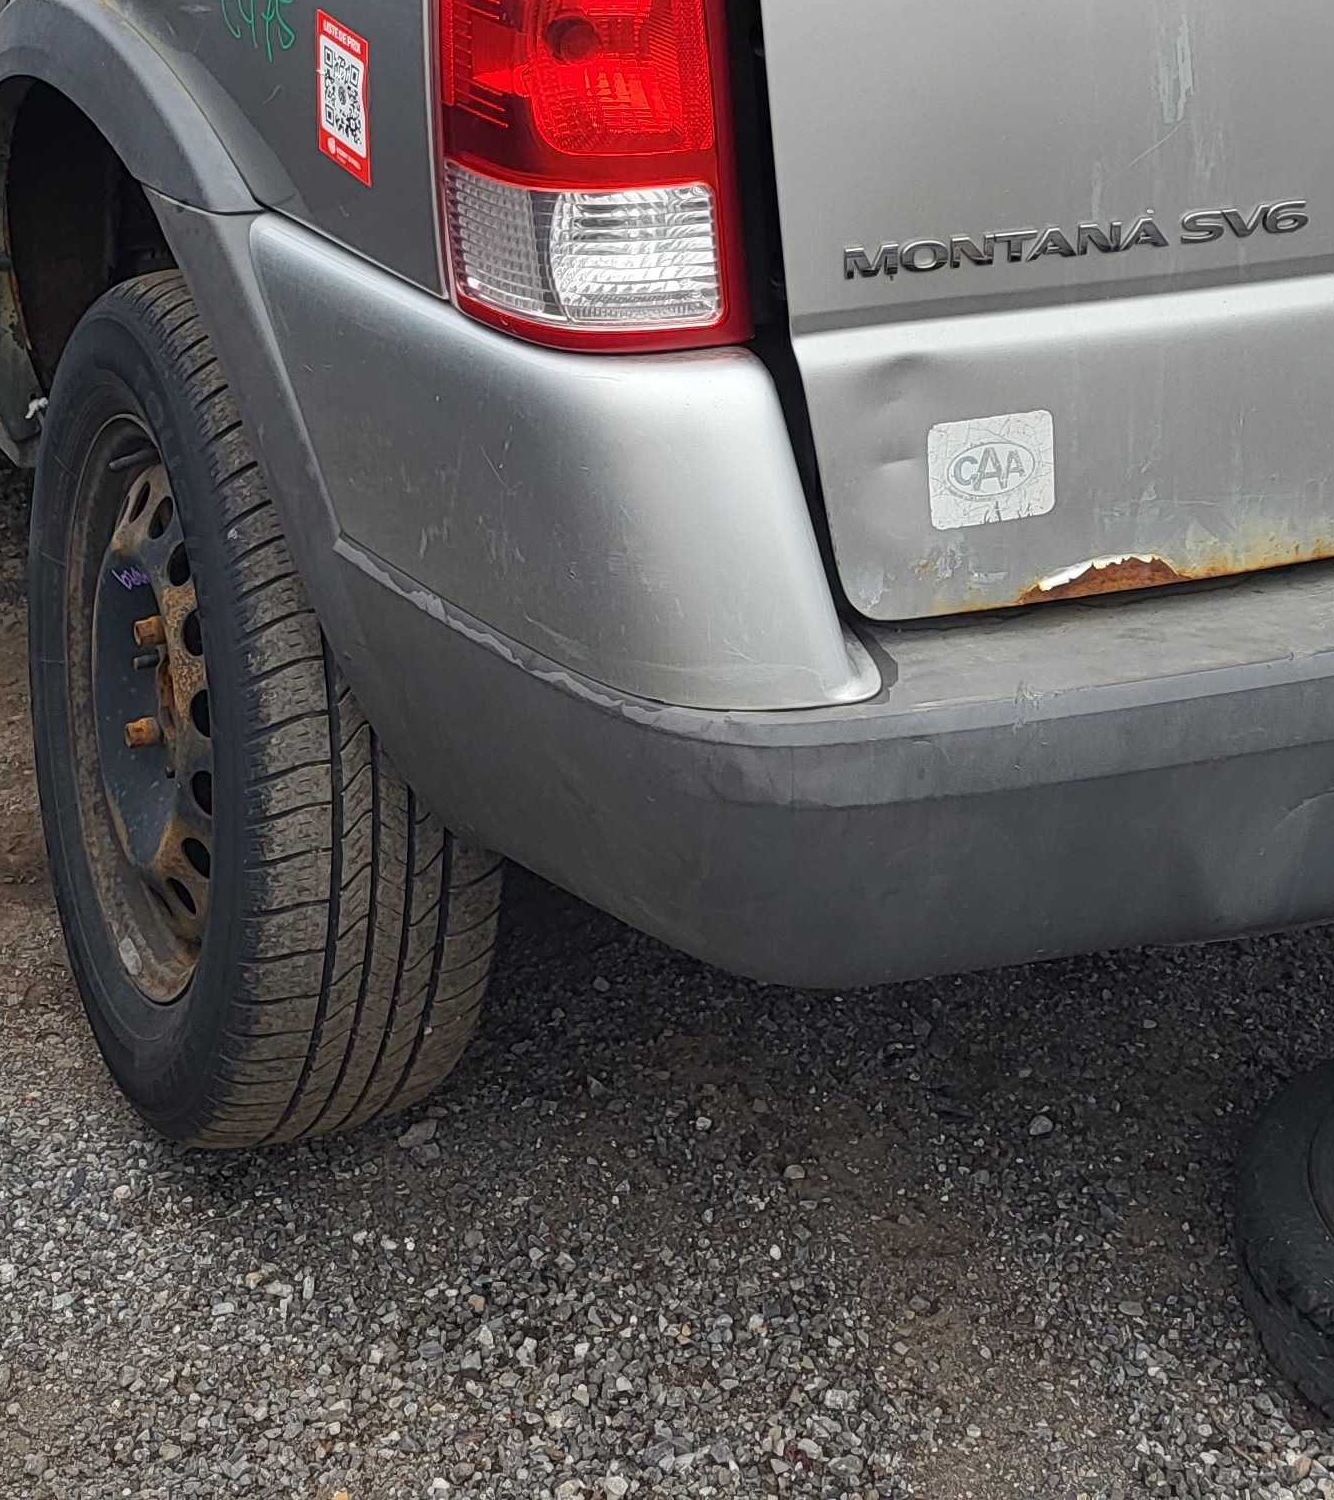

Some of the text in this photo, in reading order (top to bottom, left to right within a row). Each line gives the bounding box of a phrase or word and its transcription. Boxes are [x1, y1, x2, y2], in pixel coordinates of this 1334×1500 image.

[843, 199, 1309, 280] MONTANA SV6
[952, 446, 1026, 492] CAA
